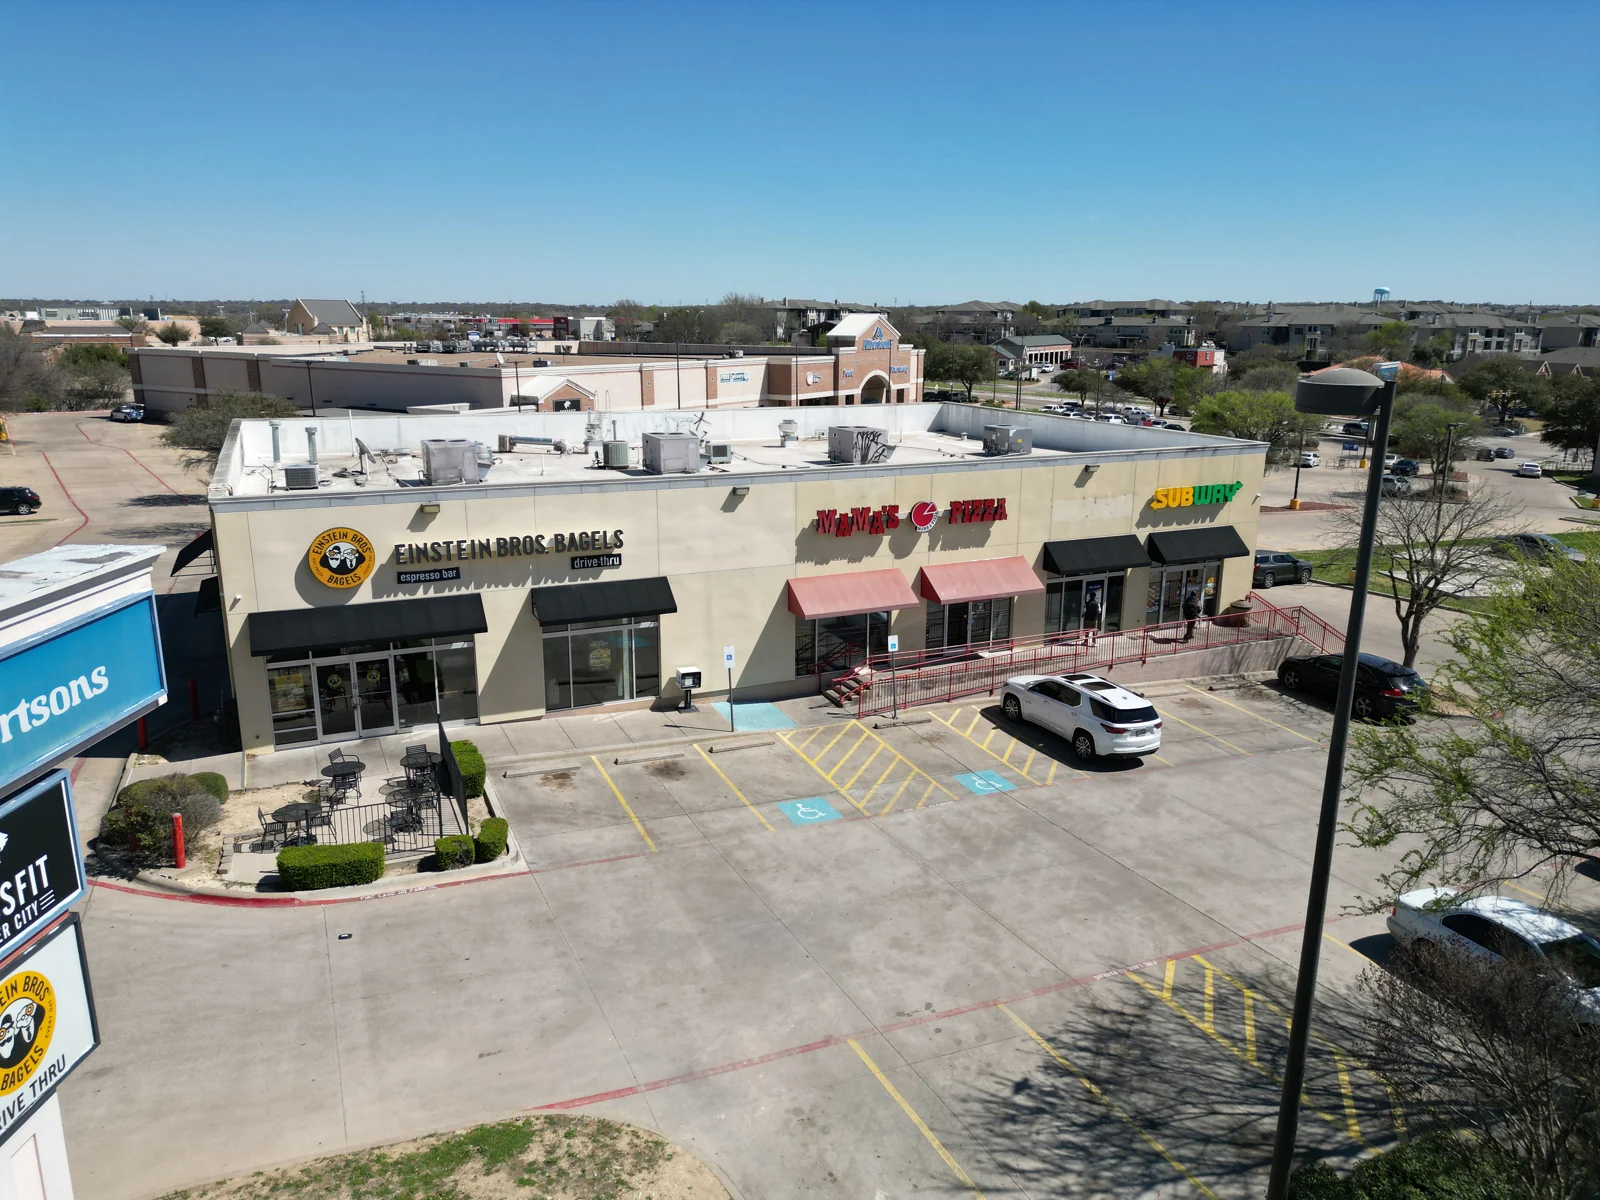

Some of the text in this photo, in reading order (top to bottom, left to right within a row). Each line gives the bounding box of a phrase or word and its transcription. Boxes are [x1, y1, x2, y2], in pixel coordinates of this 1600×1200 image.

[1150, 481, 1243, 510] SUBWAY
[816, 497, 1007, 537] MAMA'S PIZZA
[312, 531, 349, 555] EINSTEIN
[394, 529, 624, 565] EINSTEIN BROS. BAGELS
[327, 573, 361, 586] BAGELS
[400, 569, 457, 582] espresso bar
[14, 900, 38, 930] CITY
[22, 975, 50, 1002] BROS
[1, 1045, 45, 1091] BAGELS
[29, 1053, 67, 1098] THRU
